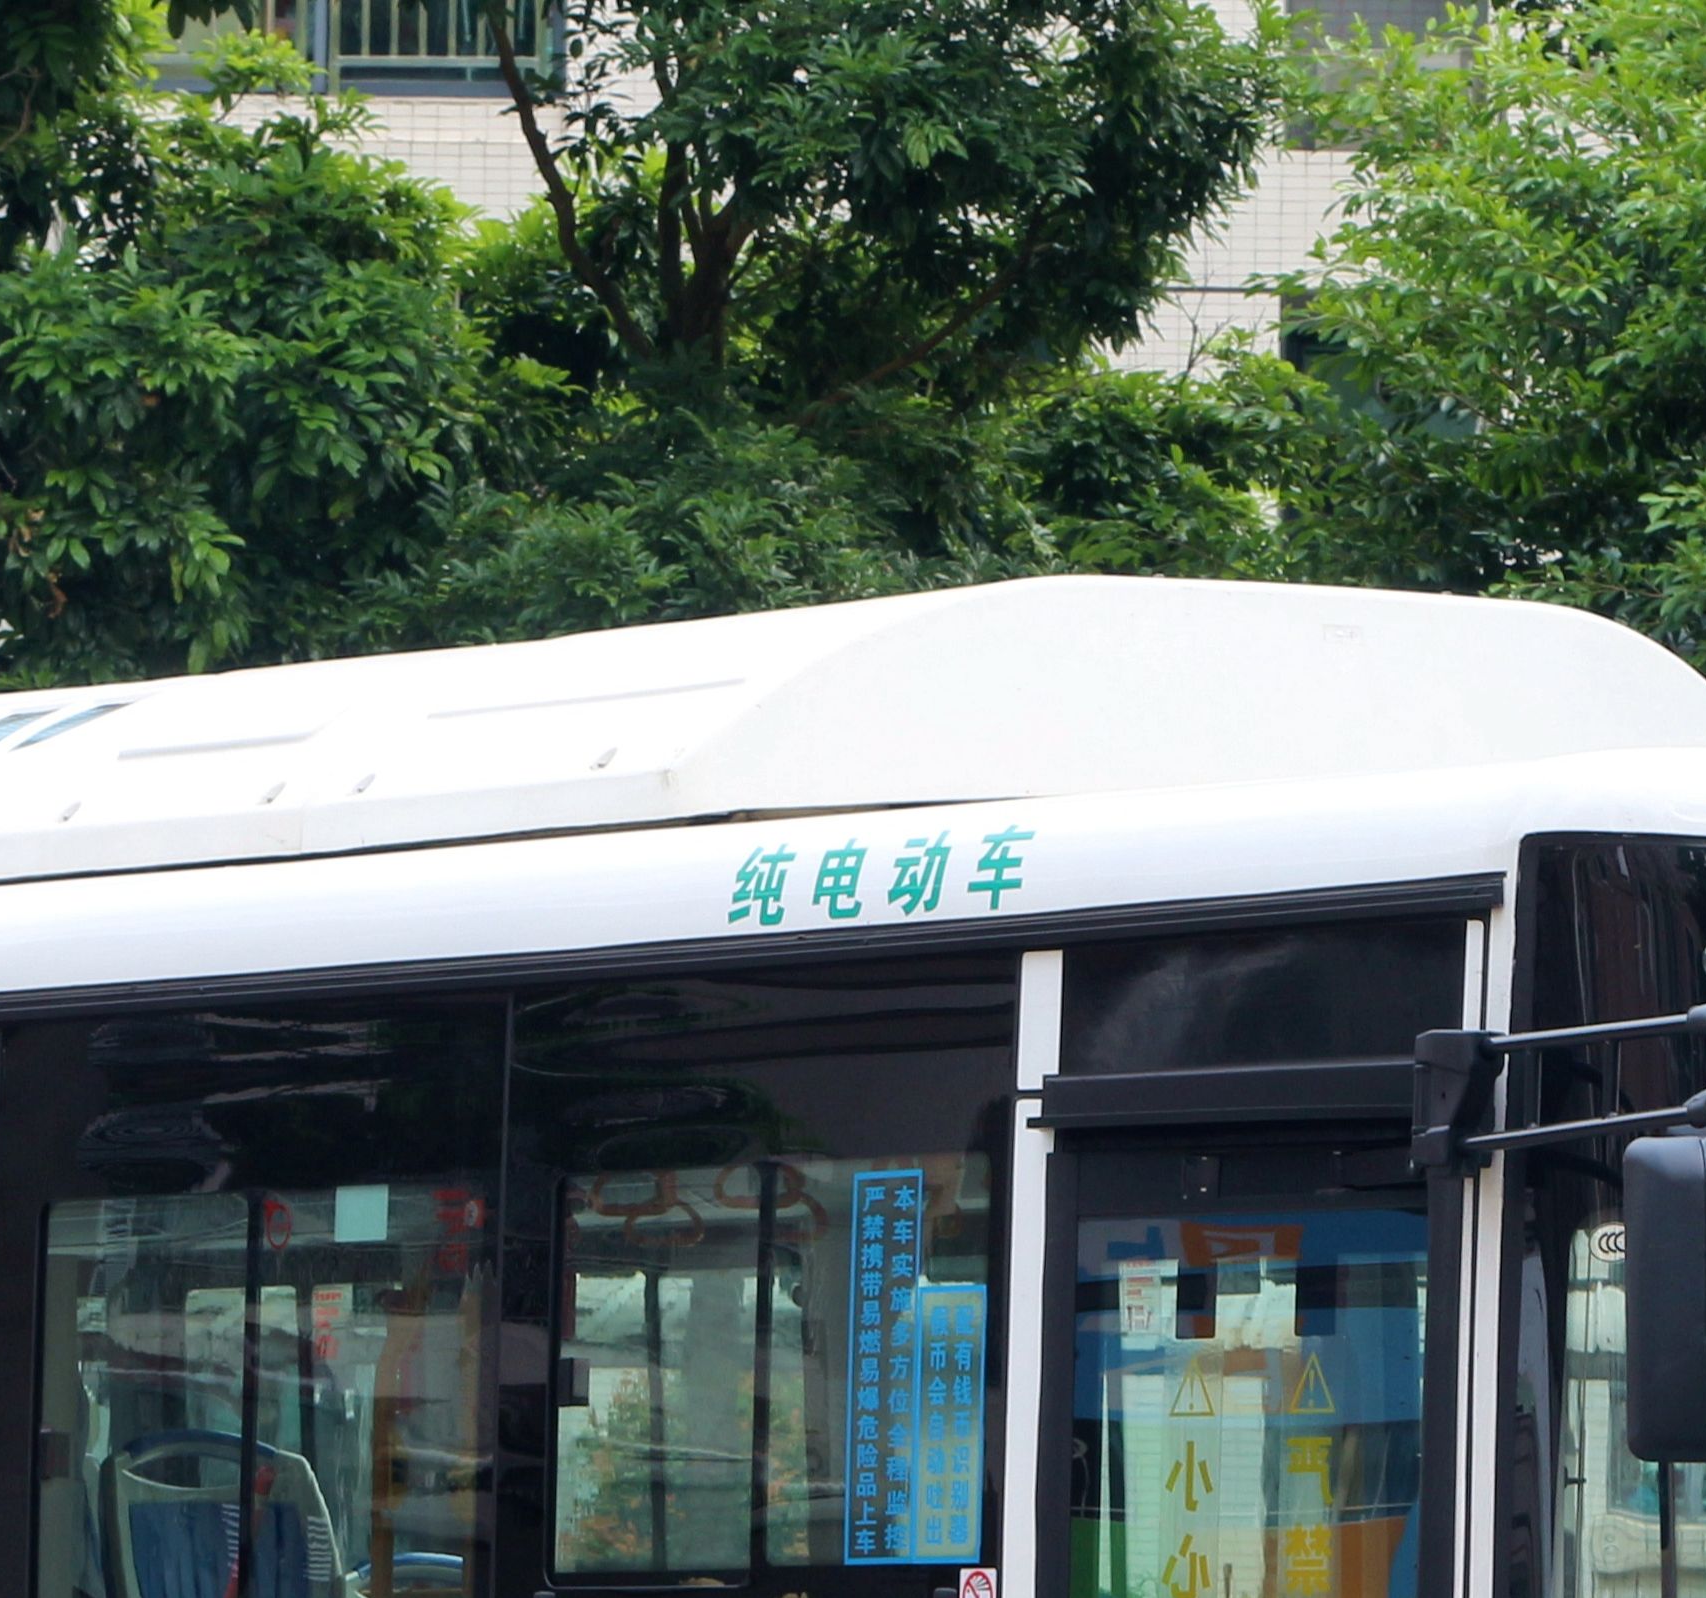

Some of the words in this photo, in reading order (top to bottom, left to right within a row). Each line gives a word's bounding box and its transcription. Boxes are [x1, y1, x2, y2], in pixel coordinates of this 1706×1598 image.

[727, 824, 1036, 926] 纯电动车
[855, 1186, 886, 1554] 严禁携带易燃易爆危险品上车
[884, 1185, 916, 1549] 本车实施多方位全程监控
